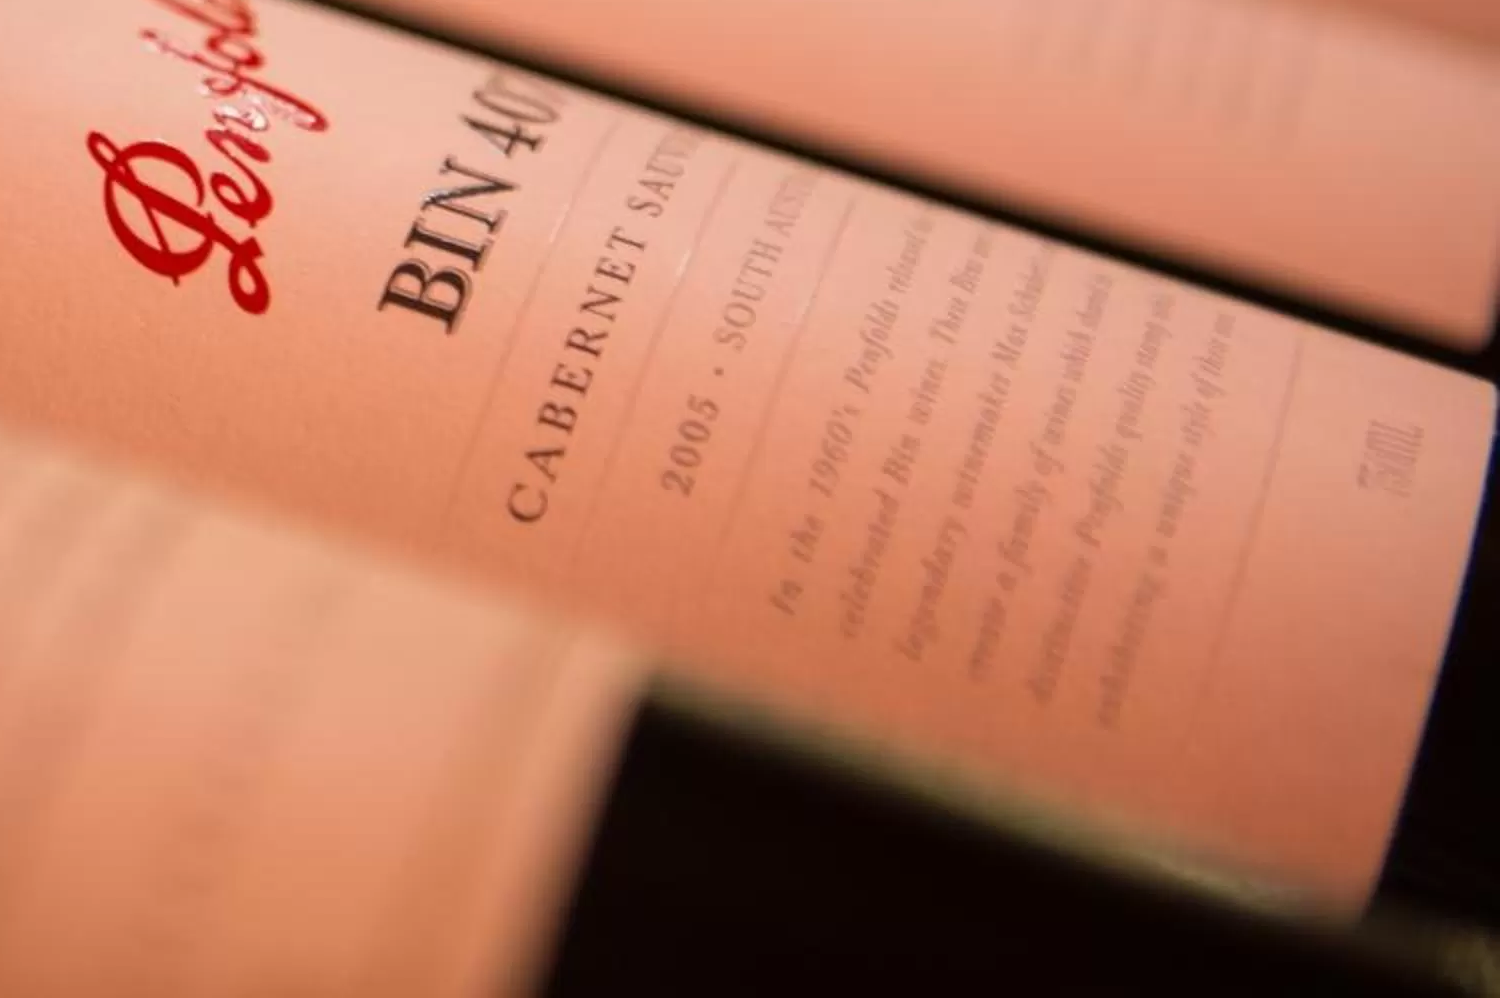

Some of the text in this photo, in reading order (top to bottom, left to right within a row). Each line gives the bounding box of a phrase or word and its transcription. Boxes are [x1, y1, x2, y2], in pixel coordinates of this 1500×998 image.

[378, 155, 520, 335] BIN
[507, 130, 698, 523] CABERNET SAUV
[661, 394, 720, 496] 2005
[717, 239, 785, 352] SOUTH
[788, 514, 824, 563] the
[809, 405, 860, 497] 1960's
[844, 300, 898, 393] Penfolds
[953, 372, 1009, 508] winemaker
[1072, 444, 1127, 548] Penfolds
